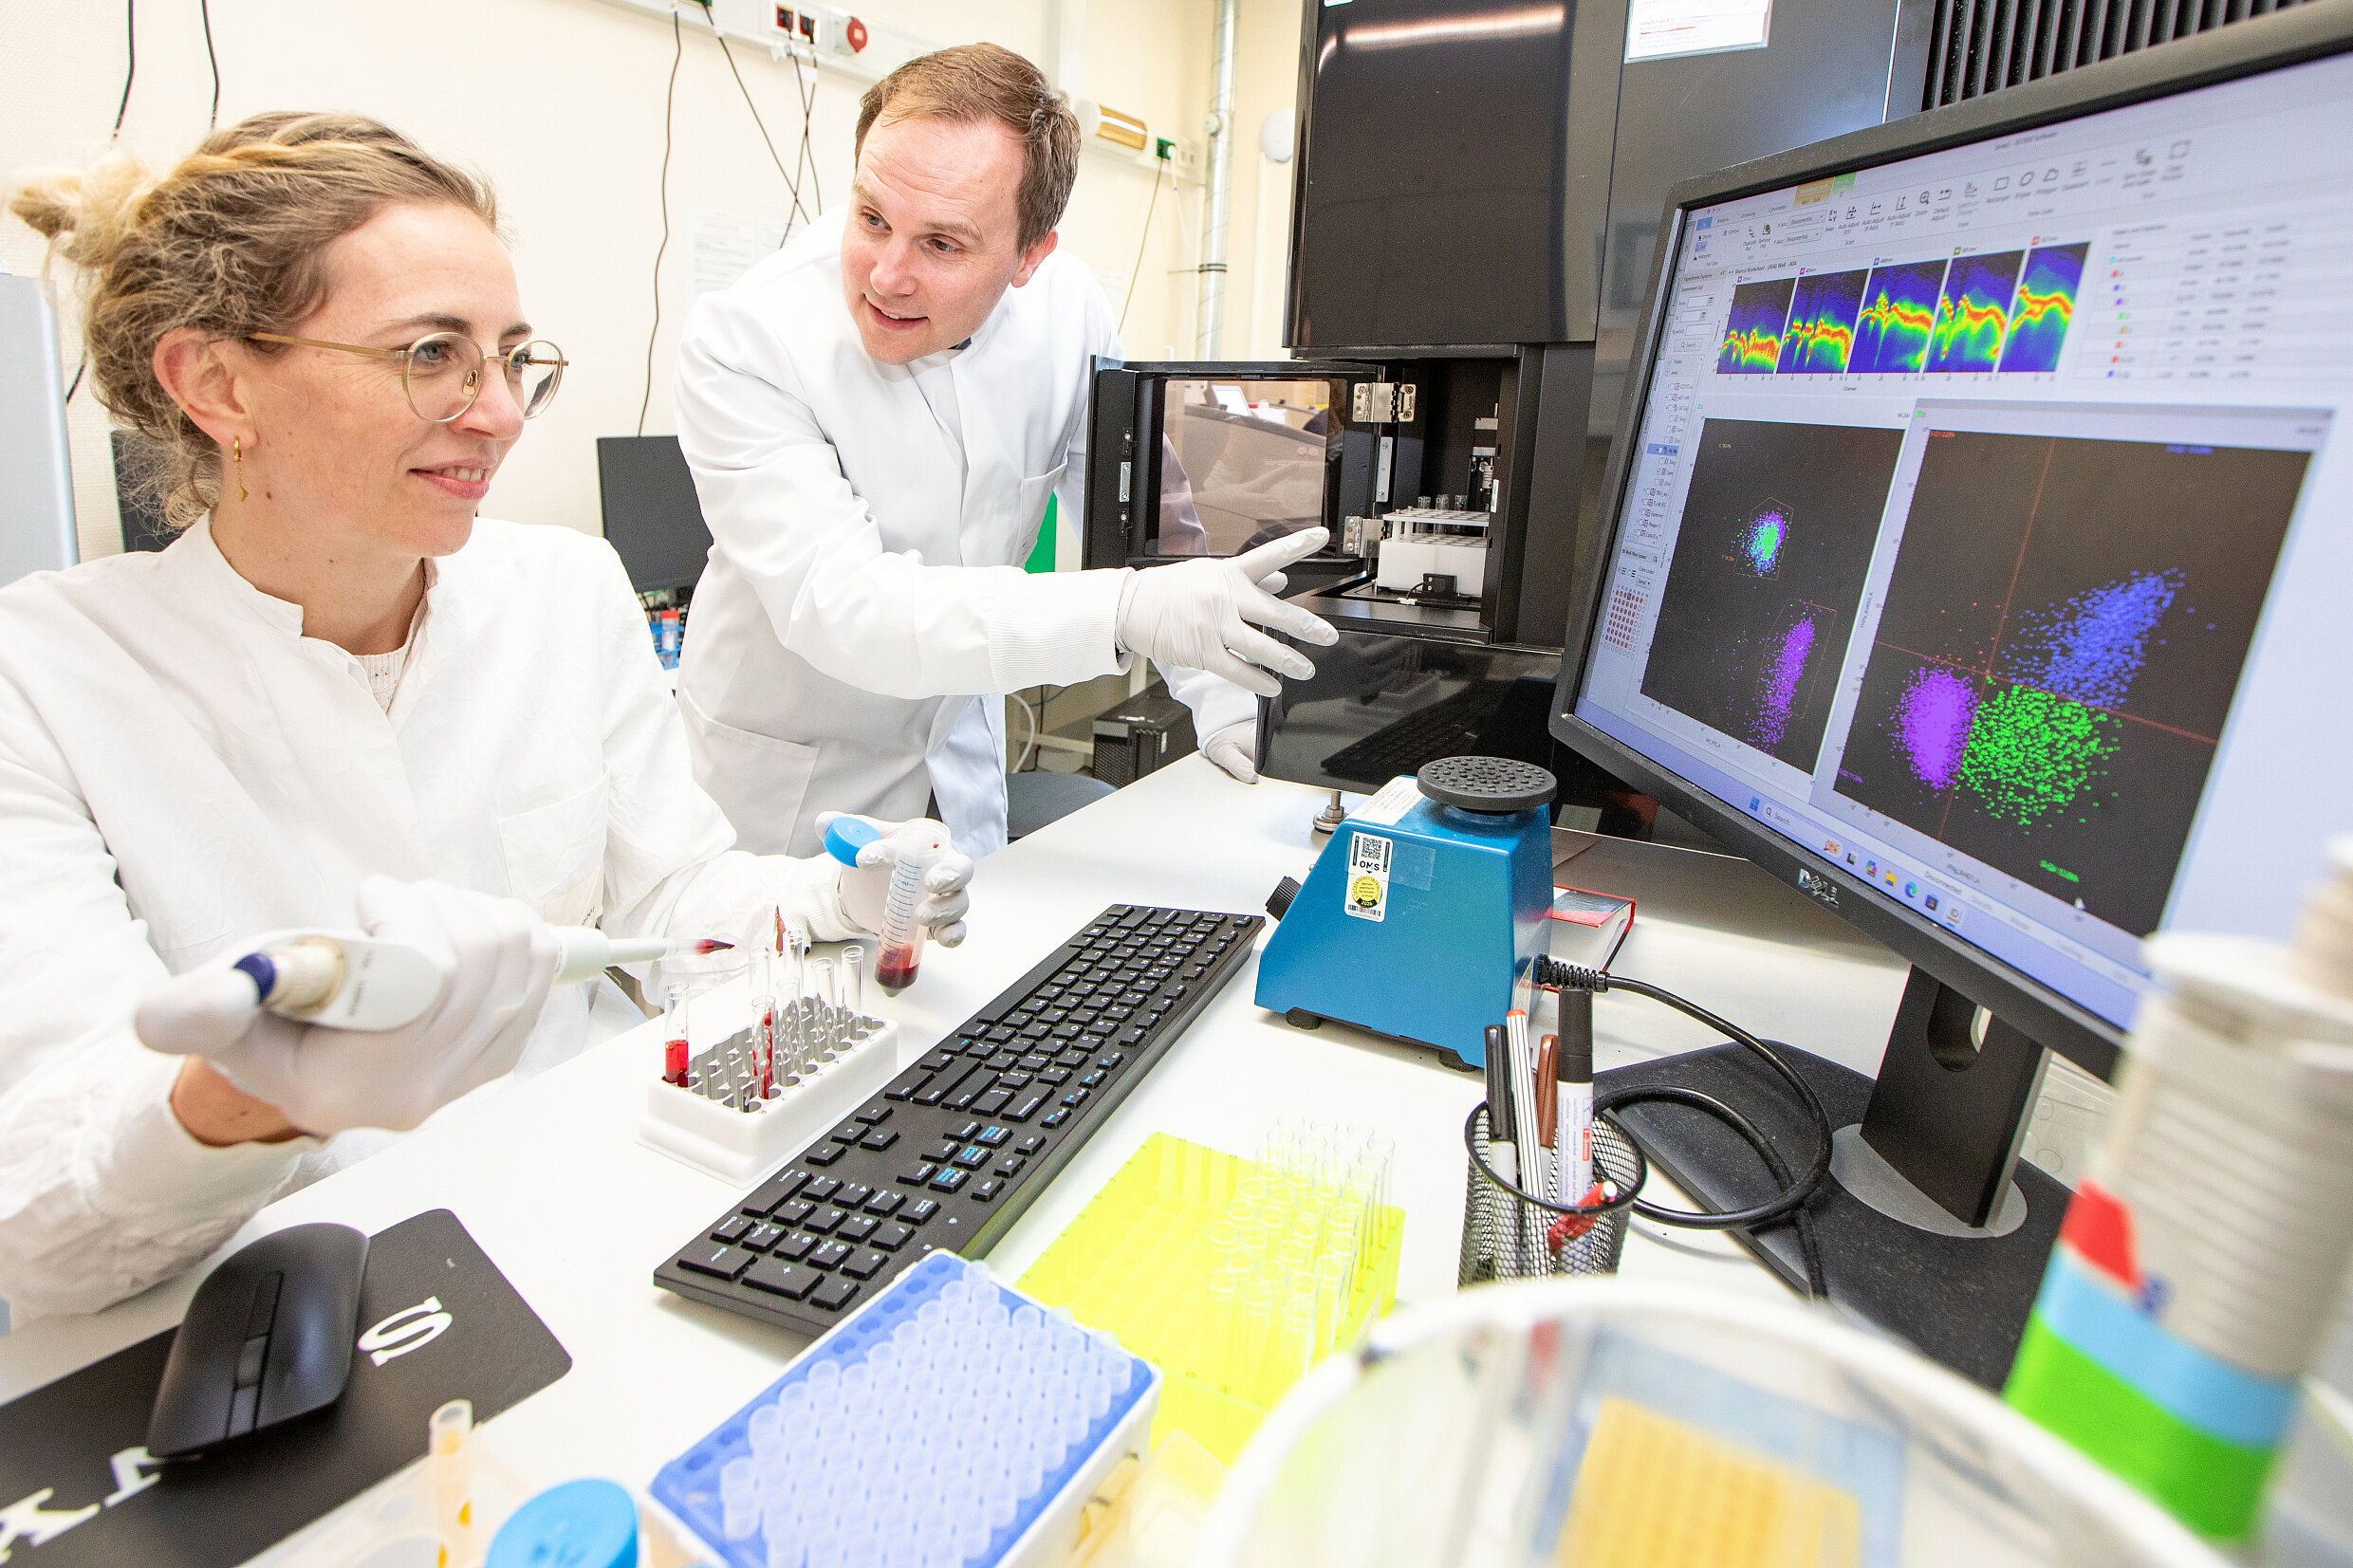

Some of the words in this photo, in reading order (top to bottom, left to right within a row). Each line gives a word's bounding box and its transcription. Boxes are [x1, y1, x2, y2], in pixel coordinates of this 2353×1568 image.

[1774, 813, 1790, 825] Search
[1359, 859, 1380, 871] OMS
[1798, 868, 1840, 911] DELL
[1924, 871, 1963, 895] Disconnected
[1018, 1098, 1038, 1115] Backspace
